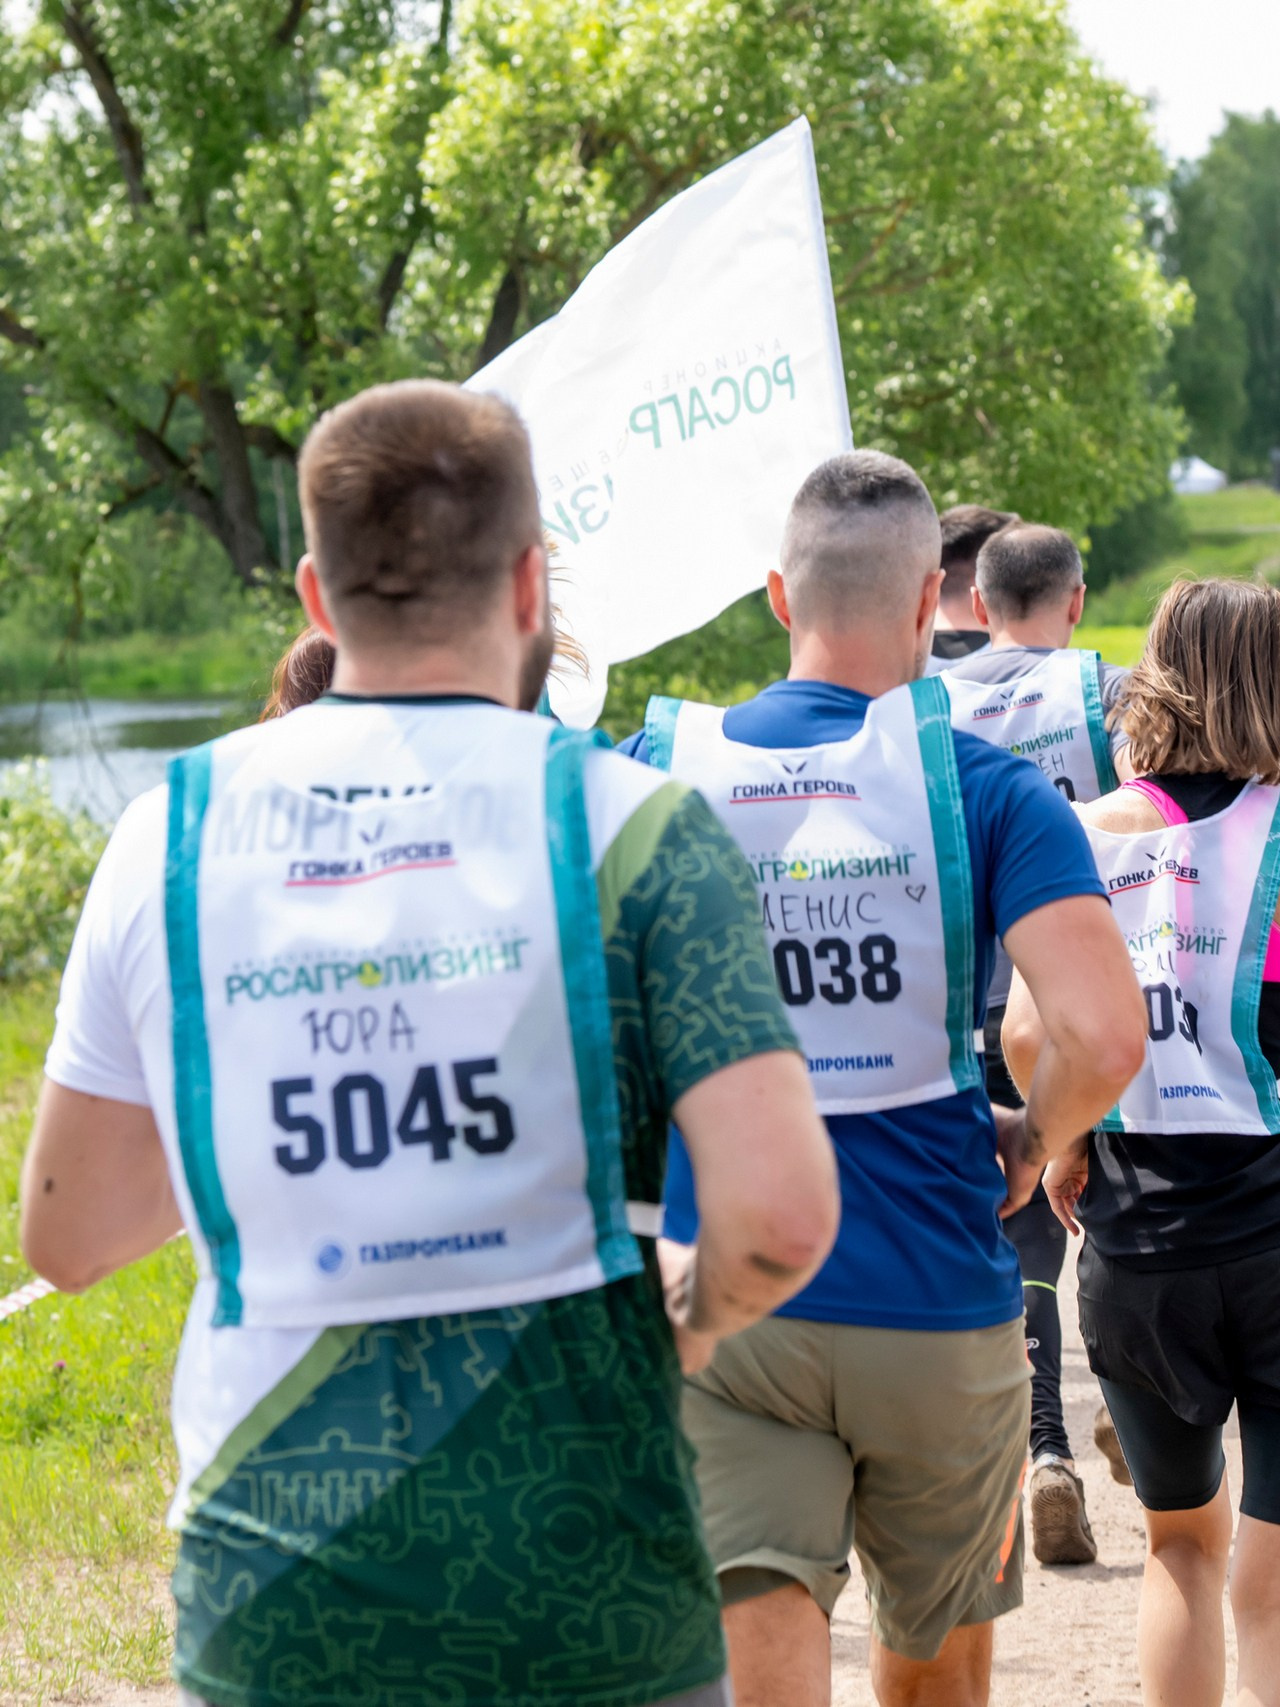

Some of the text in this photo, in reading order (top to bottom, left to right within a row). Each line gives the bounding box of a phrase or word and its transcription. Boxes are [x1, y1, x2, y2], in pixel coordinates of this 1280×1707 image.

[973, 704, 1006, 718] ГОНКА
[1002, 726, 1078, 756] ОЛИЗИНГ
[732, 780, 857, 798] ГОНКА ГЕРОЕВ
[289, 842, 454, 879] ГОНКА ГЕРОЕВ
[1109, 870, 1156, 890] ГОНКА
[225, 938, 531, 1006] РОСАГРОЛИЗИНГ
[302, 1001, 418, 1055] ЮРА
[270, 1057, 516, 1176] 5045
[359, 1228, 509, 1264] ГАЗПРОМБАНК
